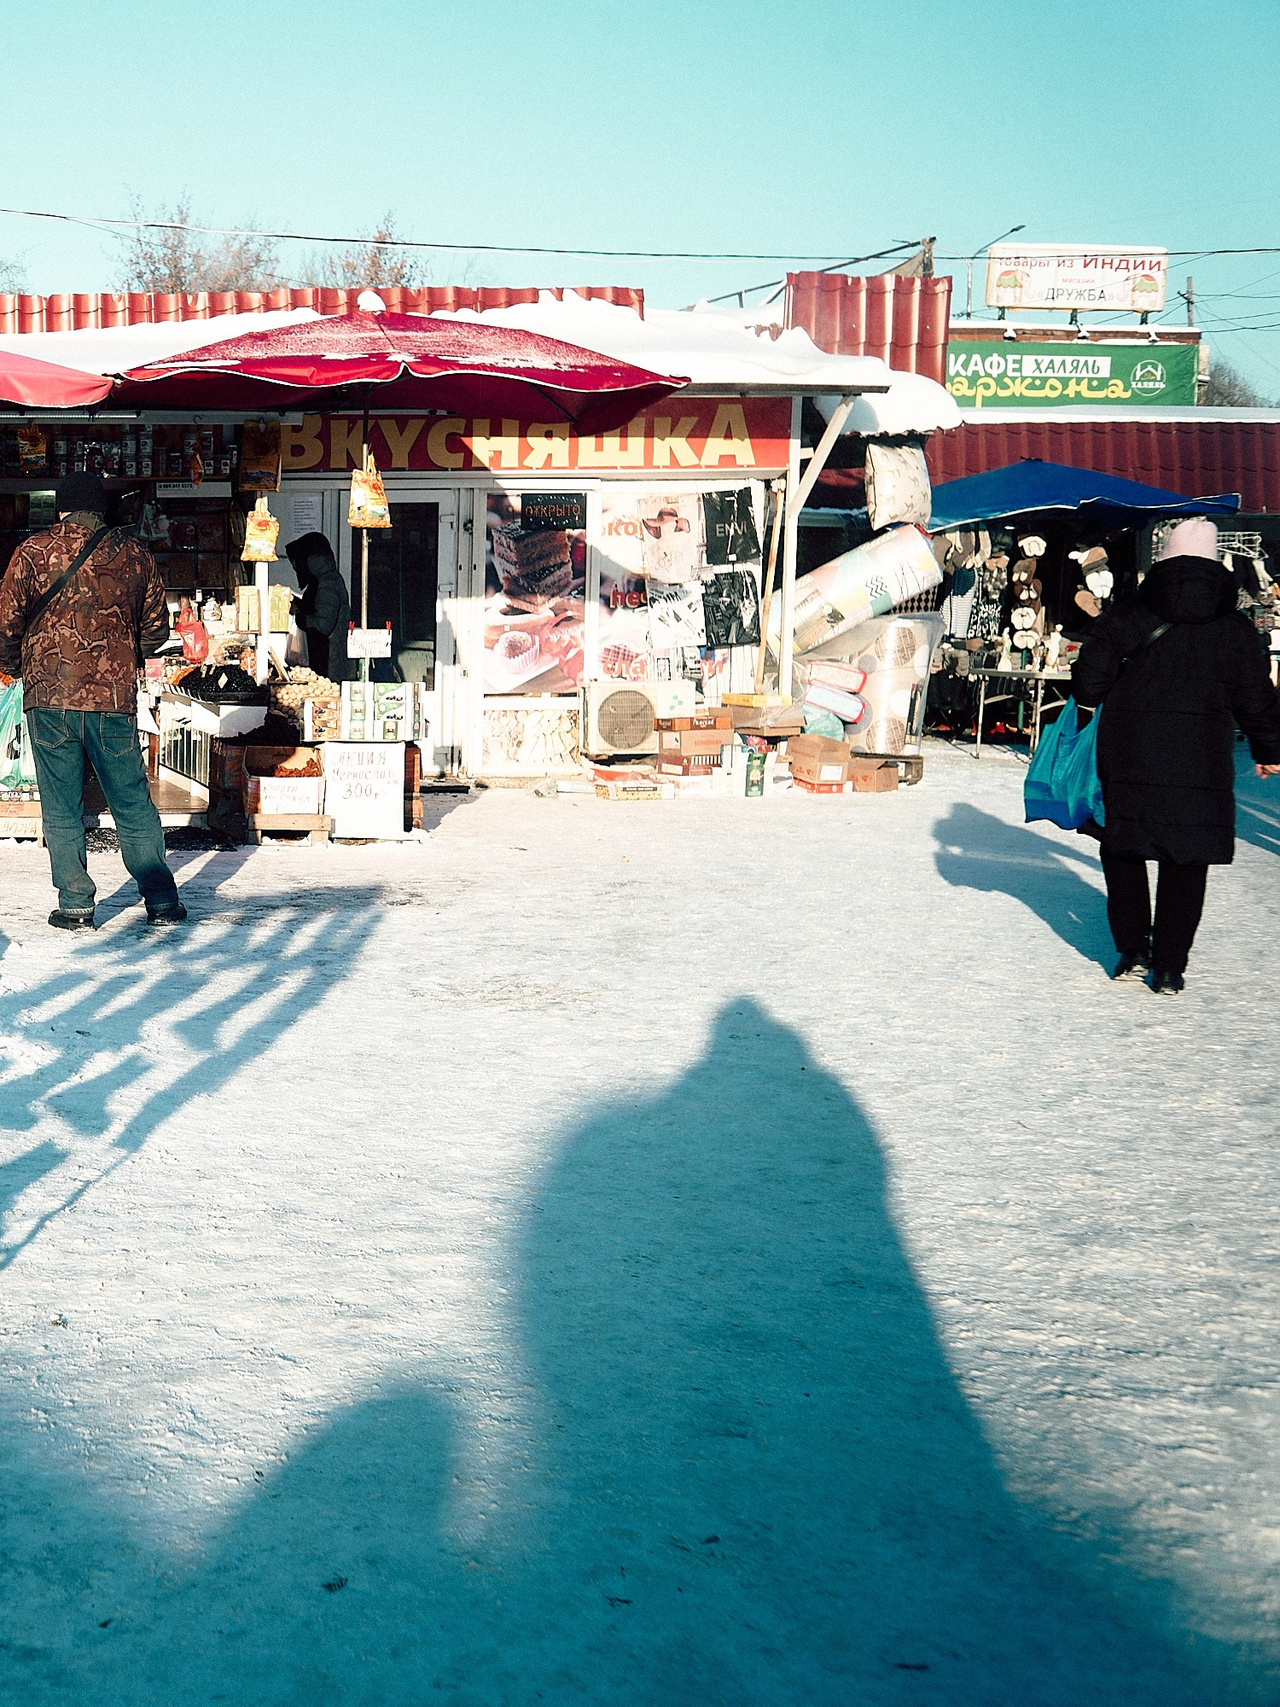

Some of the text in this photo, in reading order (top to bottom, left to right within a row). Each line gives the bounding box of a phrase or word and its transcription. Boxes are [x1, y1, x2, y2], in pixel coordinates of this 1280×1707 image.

[1057, 258, 1074, 268] из
[948, 353, 1100, 377] КАФЕ ХАЛЯЛЬ
[945, 376, 1132, 408] аржона
[524, 503, 581, 518] ОТКРЫТО
